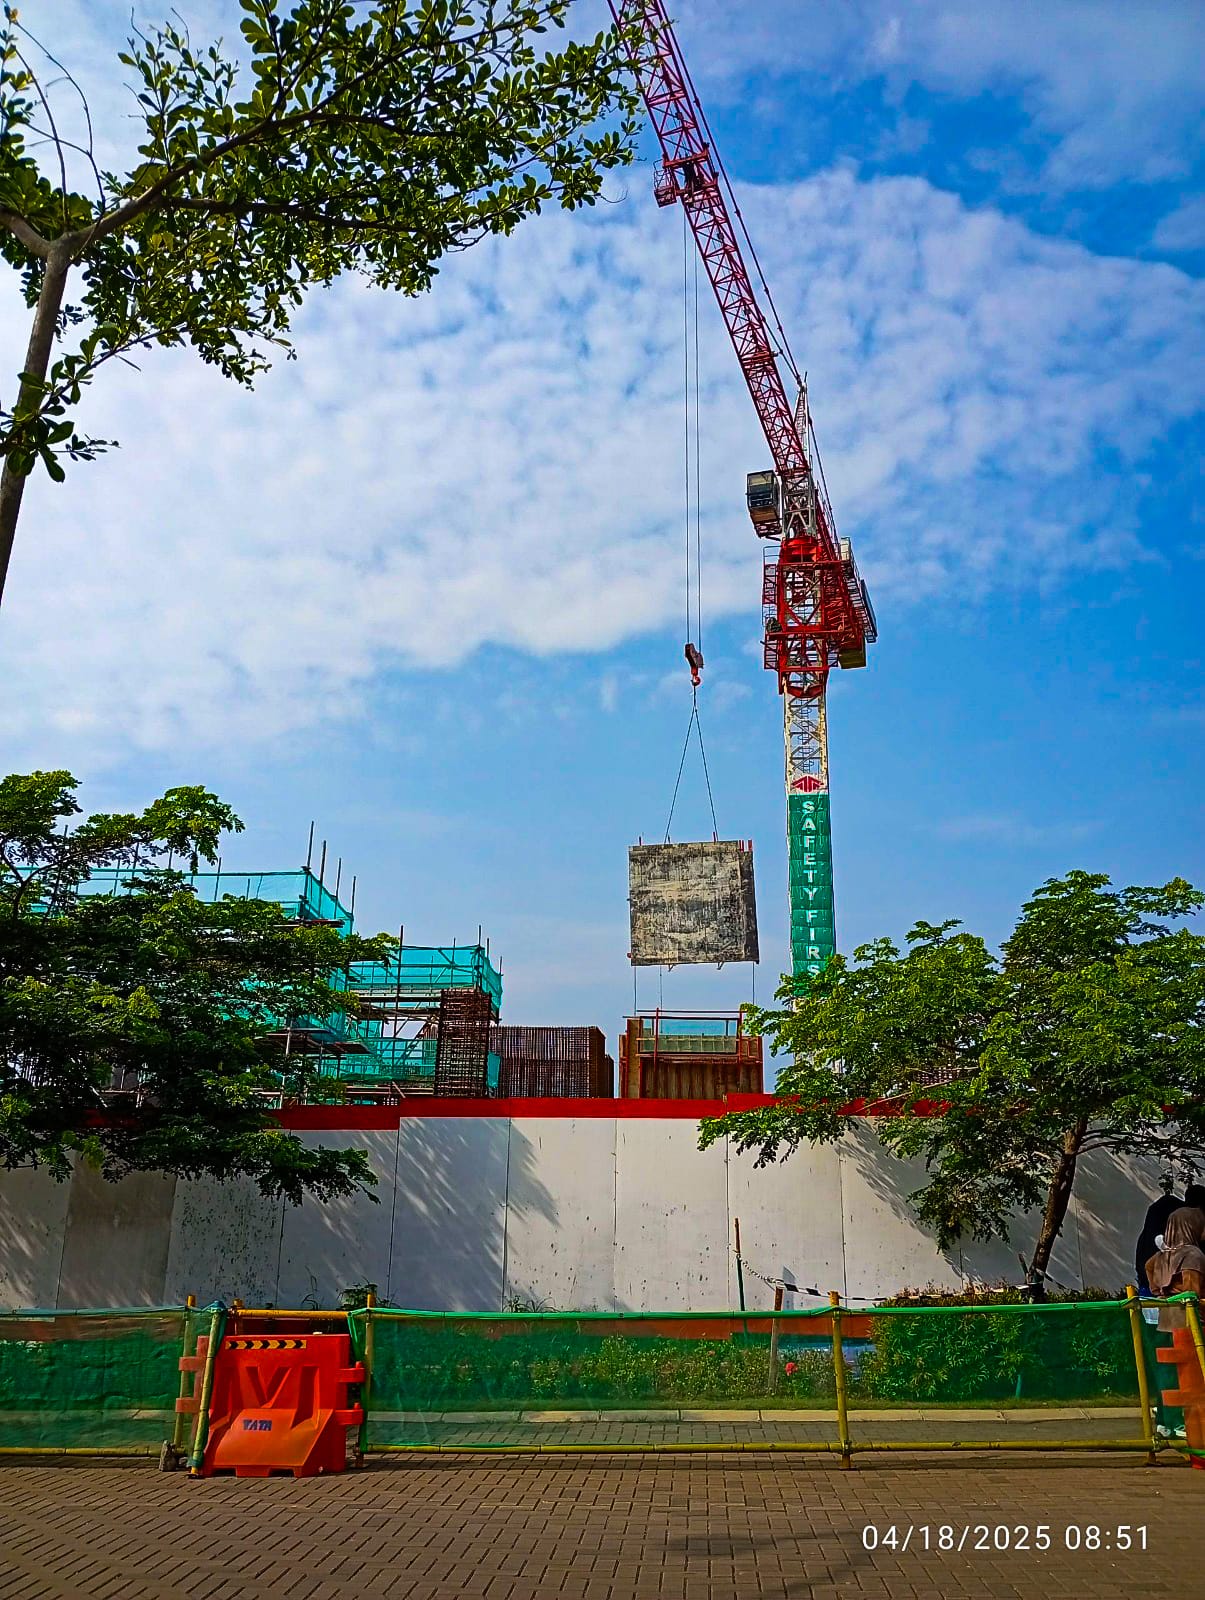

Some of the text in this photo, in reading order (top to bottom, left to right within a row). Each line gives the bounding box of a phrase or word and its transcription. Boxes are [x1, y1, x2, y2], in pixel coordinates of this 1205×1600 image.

[802, 800, 821, 977] SAFETY FIRS
[243, 1420, 272, 1431] TATA
